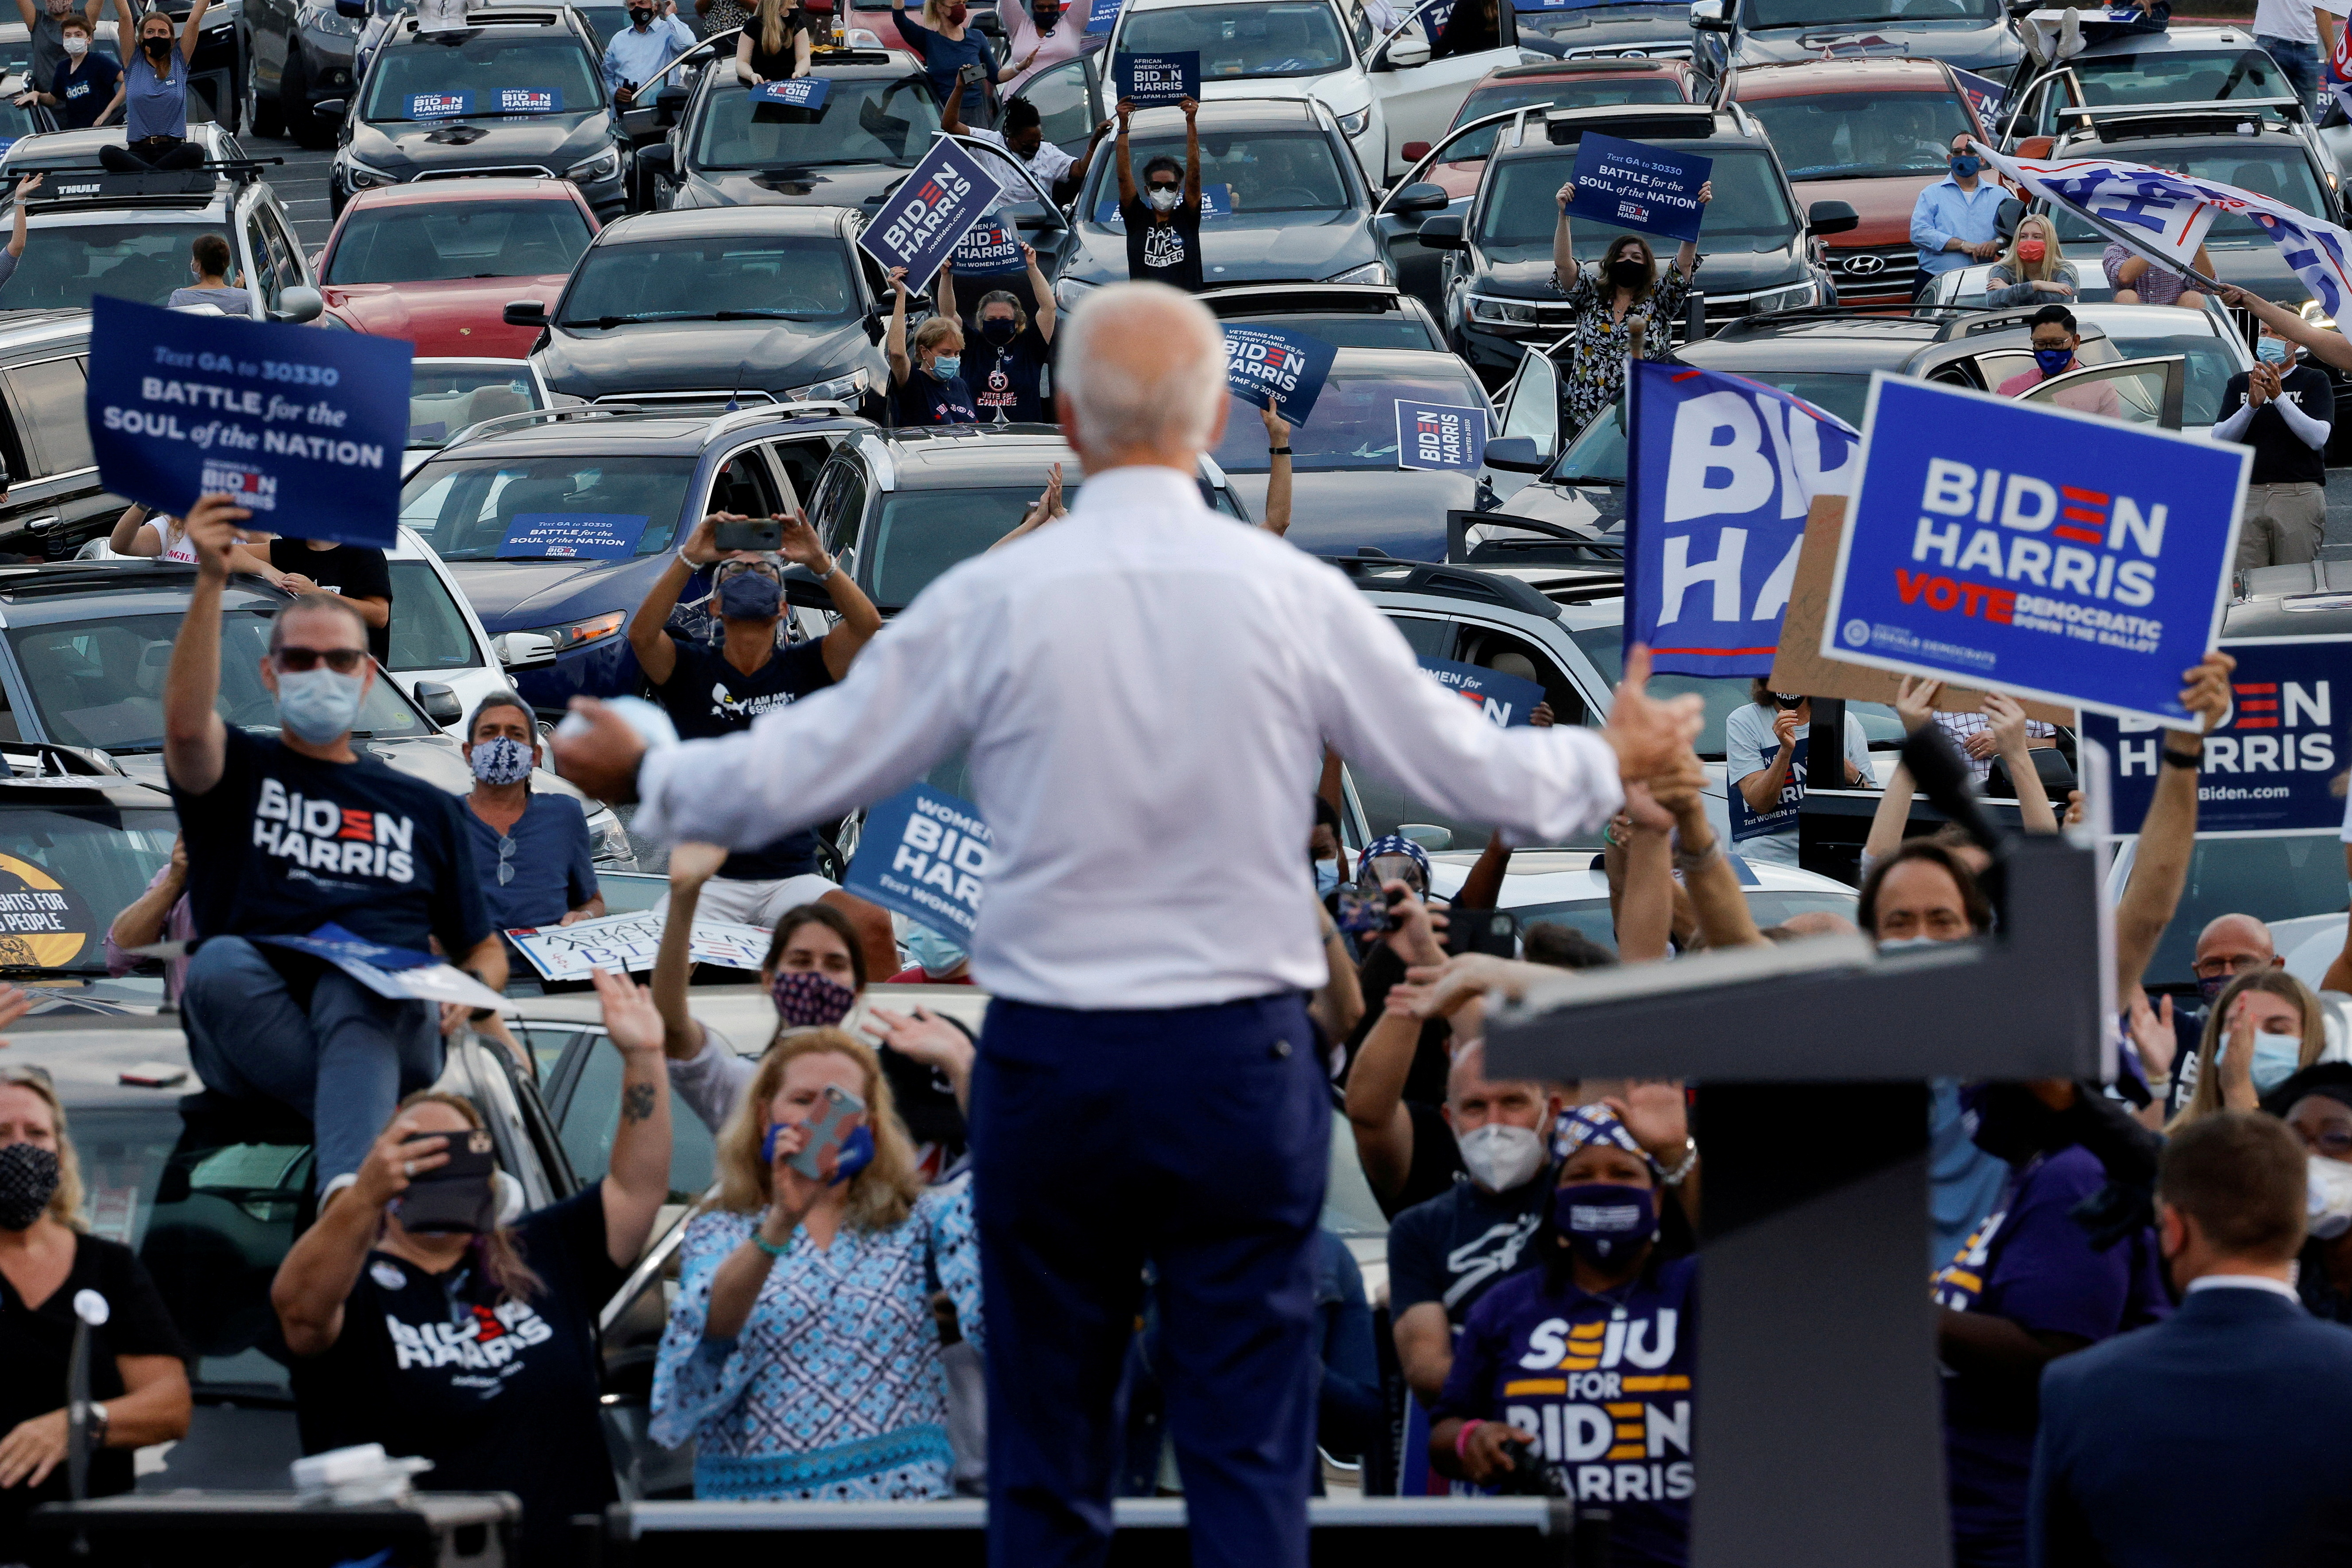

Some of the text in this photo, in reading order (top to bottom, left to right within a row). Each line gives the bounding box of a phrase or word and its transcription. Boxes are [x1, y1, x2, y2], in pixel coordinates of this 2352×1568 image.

[767, 87, 809, 97] BIDEN
[1134, 81, 1183, 91] HARRIS
[414, 97, 463, 107] BIDEN
[414, 104, 463, 112] HARRIS
[1606, 152, 1624, 163] Text
[1625, 157, 1639, 166] GA
[1651, 163, 1682, 175] 30330
[57, 184, 101, 194] THULE
[1599, 165, 1684, 191] BATTLE for the
[882, 161, 959, 251] BIDEN
[1579, 176, 1697, 209] SOUL of the NATION
[898, 177, 971, 263] HARRIS
[1617, 211, 1647, 222] HARRIS
[1619, 204, 1649, 217] BIDEN
[927, 207, 966, 253] JoeBiden.com
[958, 227, 1012, 246] BIDEN
[958, 243, 1015, 259] HARRIS
[1146, 251, 1183, 266] MATTER
[1226, 334, 1261, 343] MILITARY
[1261, 340, 1296, 352] FAMILIES
[1229, 329, 1268, 338] VETERANS
[198, 352, 233, 374] GA
[262, 360, 340, 387] 30330
[1223, 340, 1306, 376] BIDEN
[142, 376, 348, 427] BATTLE for the
[977, 396, 1017, 407] CHANGE
[1228, 375, 1251, 385] VMF
[1260, 385, 1286, 403] 30330
[950, 404, 975, 418] JOE
[104, 406, 186, 440] SOUL
[190, 420, 222, 449] of
[218, 424, 259, 450] the
[264, 430, 384, 469] NATION
[1417, 411, 1441, 462] BIDEN
[1441, 414, 1461, 464] HARRIS
[1664, 391, 1860, 523] BID
[201, 469, 278, 494] BIDEN
[1922, 457, 2168, 558] BIDEN
[1912, 516, 2157, 608] HARRIS
[1895, 568, 2163, 640] VOTE DEMOCRATIC
[2066, 624, 2096, 642] THE
[2098, 630, 2160, 654] BALLOT
[1418, 667, 1482, 689] OMEN for
[754, 695, 770, 705] AM
[772, 691, 787, 701] AN
[2119, 732, 2336, 777] HRRIS
[2198, 786, 2290, 801] Biden.com
[256, 777, 414, 852] BIDEN
[1757, 808, 1787, 822] WOMEN
[253, 818, 415, 883] HARRIS
[903, 813, 993, 877] BID
[892, 844, 984, 912] HAR
[0, 893, 69, 911] GHTS FOR
[5, 912, 66, 931] PEOPLE
[1568, 1371, 1622, 1400] FOR
[1507, 1400, 1690, 1462] BIDEN
[1559, 1461, 1696, 1502] RRIS
